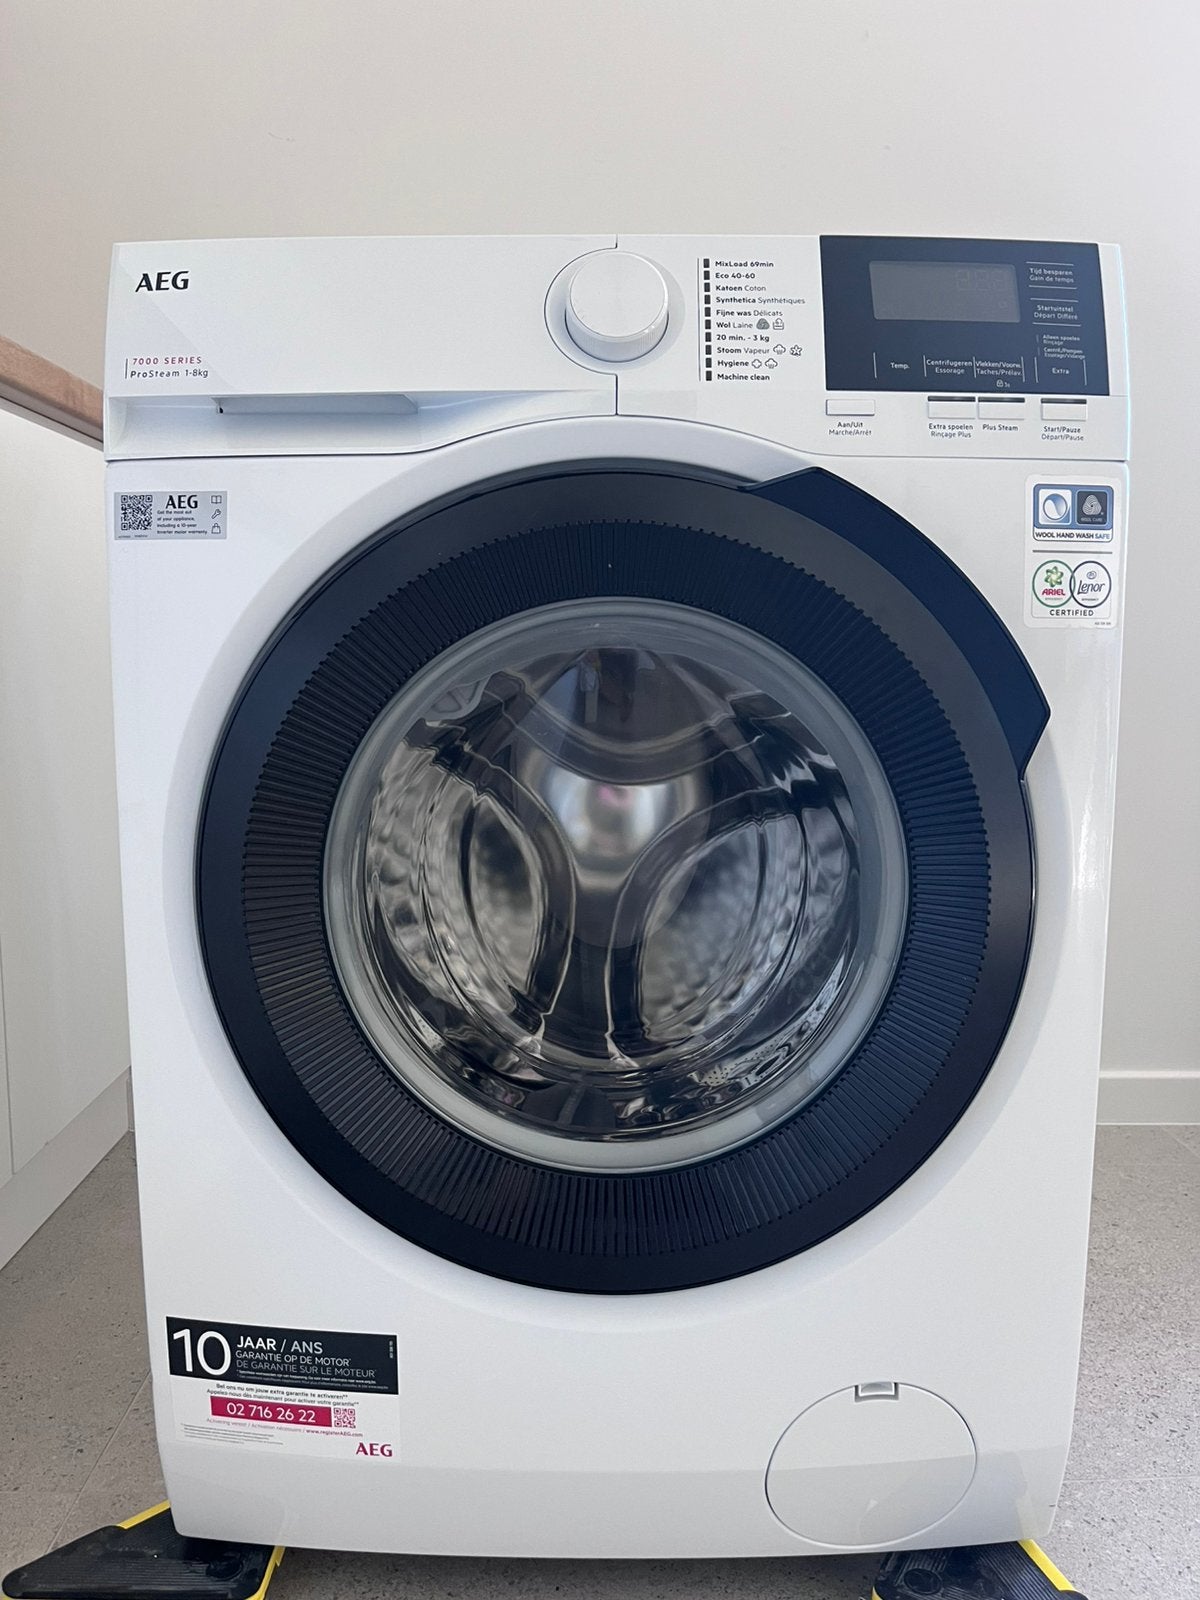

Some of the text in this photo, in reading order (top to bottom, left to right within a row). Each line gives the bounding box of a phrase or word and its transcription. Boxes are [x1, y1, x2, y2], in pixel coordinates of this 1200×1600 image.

[1029, 267, 1073, 276] Tijd besparen
[135, 271, 189, 292] AEG
[757, 296, 806, 305] Synthétiques
[716, 309, 735, 318] Fijne
[760, 334, 770, 343] kg
[717, 346, 770, 355] Stoom Vapeur
[133, 356, 202, 365] 7000 SERIES
[926, 359, 973, 368] Centrifugeren
[130, 368, 208, 379] ProSteam 1-8kg
[935, 367, 965, 375] Essorage
[717, 373, 748, 381] Machine
[948, 423, 974, 431] spoelen
[982, 423, 997, 431] Plus
[1043, 425, 1081, 433] Start/Pauze
[829, 428, 872, 436] Marche/Arrêt
[931, 430, 956, 439] Rinçage
[1041, 433, 1084, 441] Départ/Pause
[165, 494, 198, 509] AEG
[1035, 531, 1056, 539] WOOL
[1042, 588, 1066, 596] ARIEL
[1077, 580, 1106, 595] Lenor
[1049, 609, 1094, 617] CERTIFIED
[237, 1336, 323, 1354] JAAR / ANS
[173, 1328, 231, 1375] 10
[236, 1350, 281, 1362] GARANTIE
[284, 1354, 297, 1363] OP
[300, 1355, 313, 1365] DE
[236, 1360, 248, 1369] DE
[251, 1361, 297, 1373] GARANTIE
[300, 1365, 318, 1375] SUR
[320, 1367, 332, 1376] LE
[255, 1387, 268, 1395] jouw
[285, 1390, 308, 1398] garantie
[253, 1393, 283, 1401] maintenant
[298, 1396, 316, 1404] activer
[226, 1402, 316, 1423] 02 716 26 22
[306, 1428, 363, 1438] www.registerAEG.com
[356, 1442, 393, 1457] AEG
